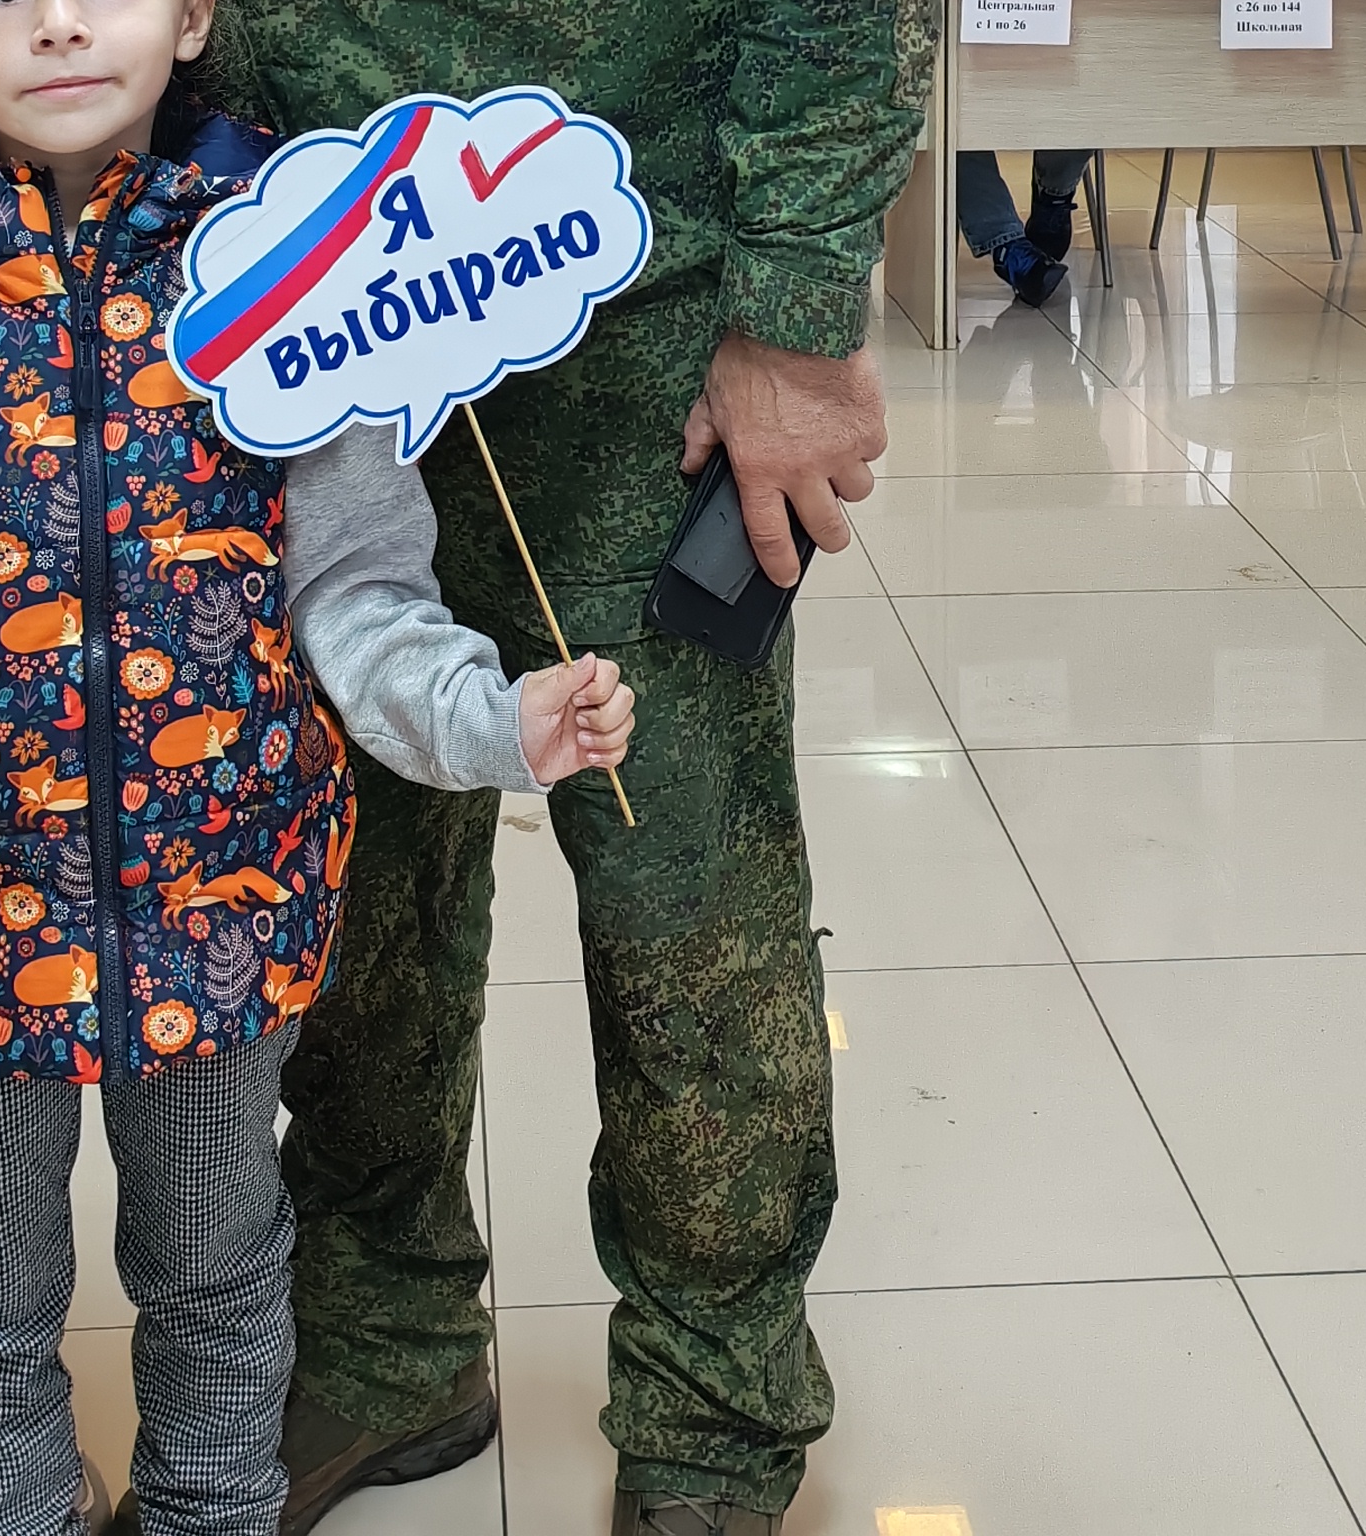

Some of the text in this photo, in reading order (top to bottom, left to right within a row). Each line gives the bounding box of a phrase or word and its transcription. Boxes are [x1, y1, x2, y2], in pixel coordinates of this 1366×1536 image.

[1236, 1, 1301, 12] с 26 по 144
[976, 19, 1027, 30] с 1 по 26
[1237, 21, 1303, 32] Школьная
[378, 174, 435, 255] Я
[264, 210, 601, 390] выбираю
